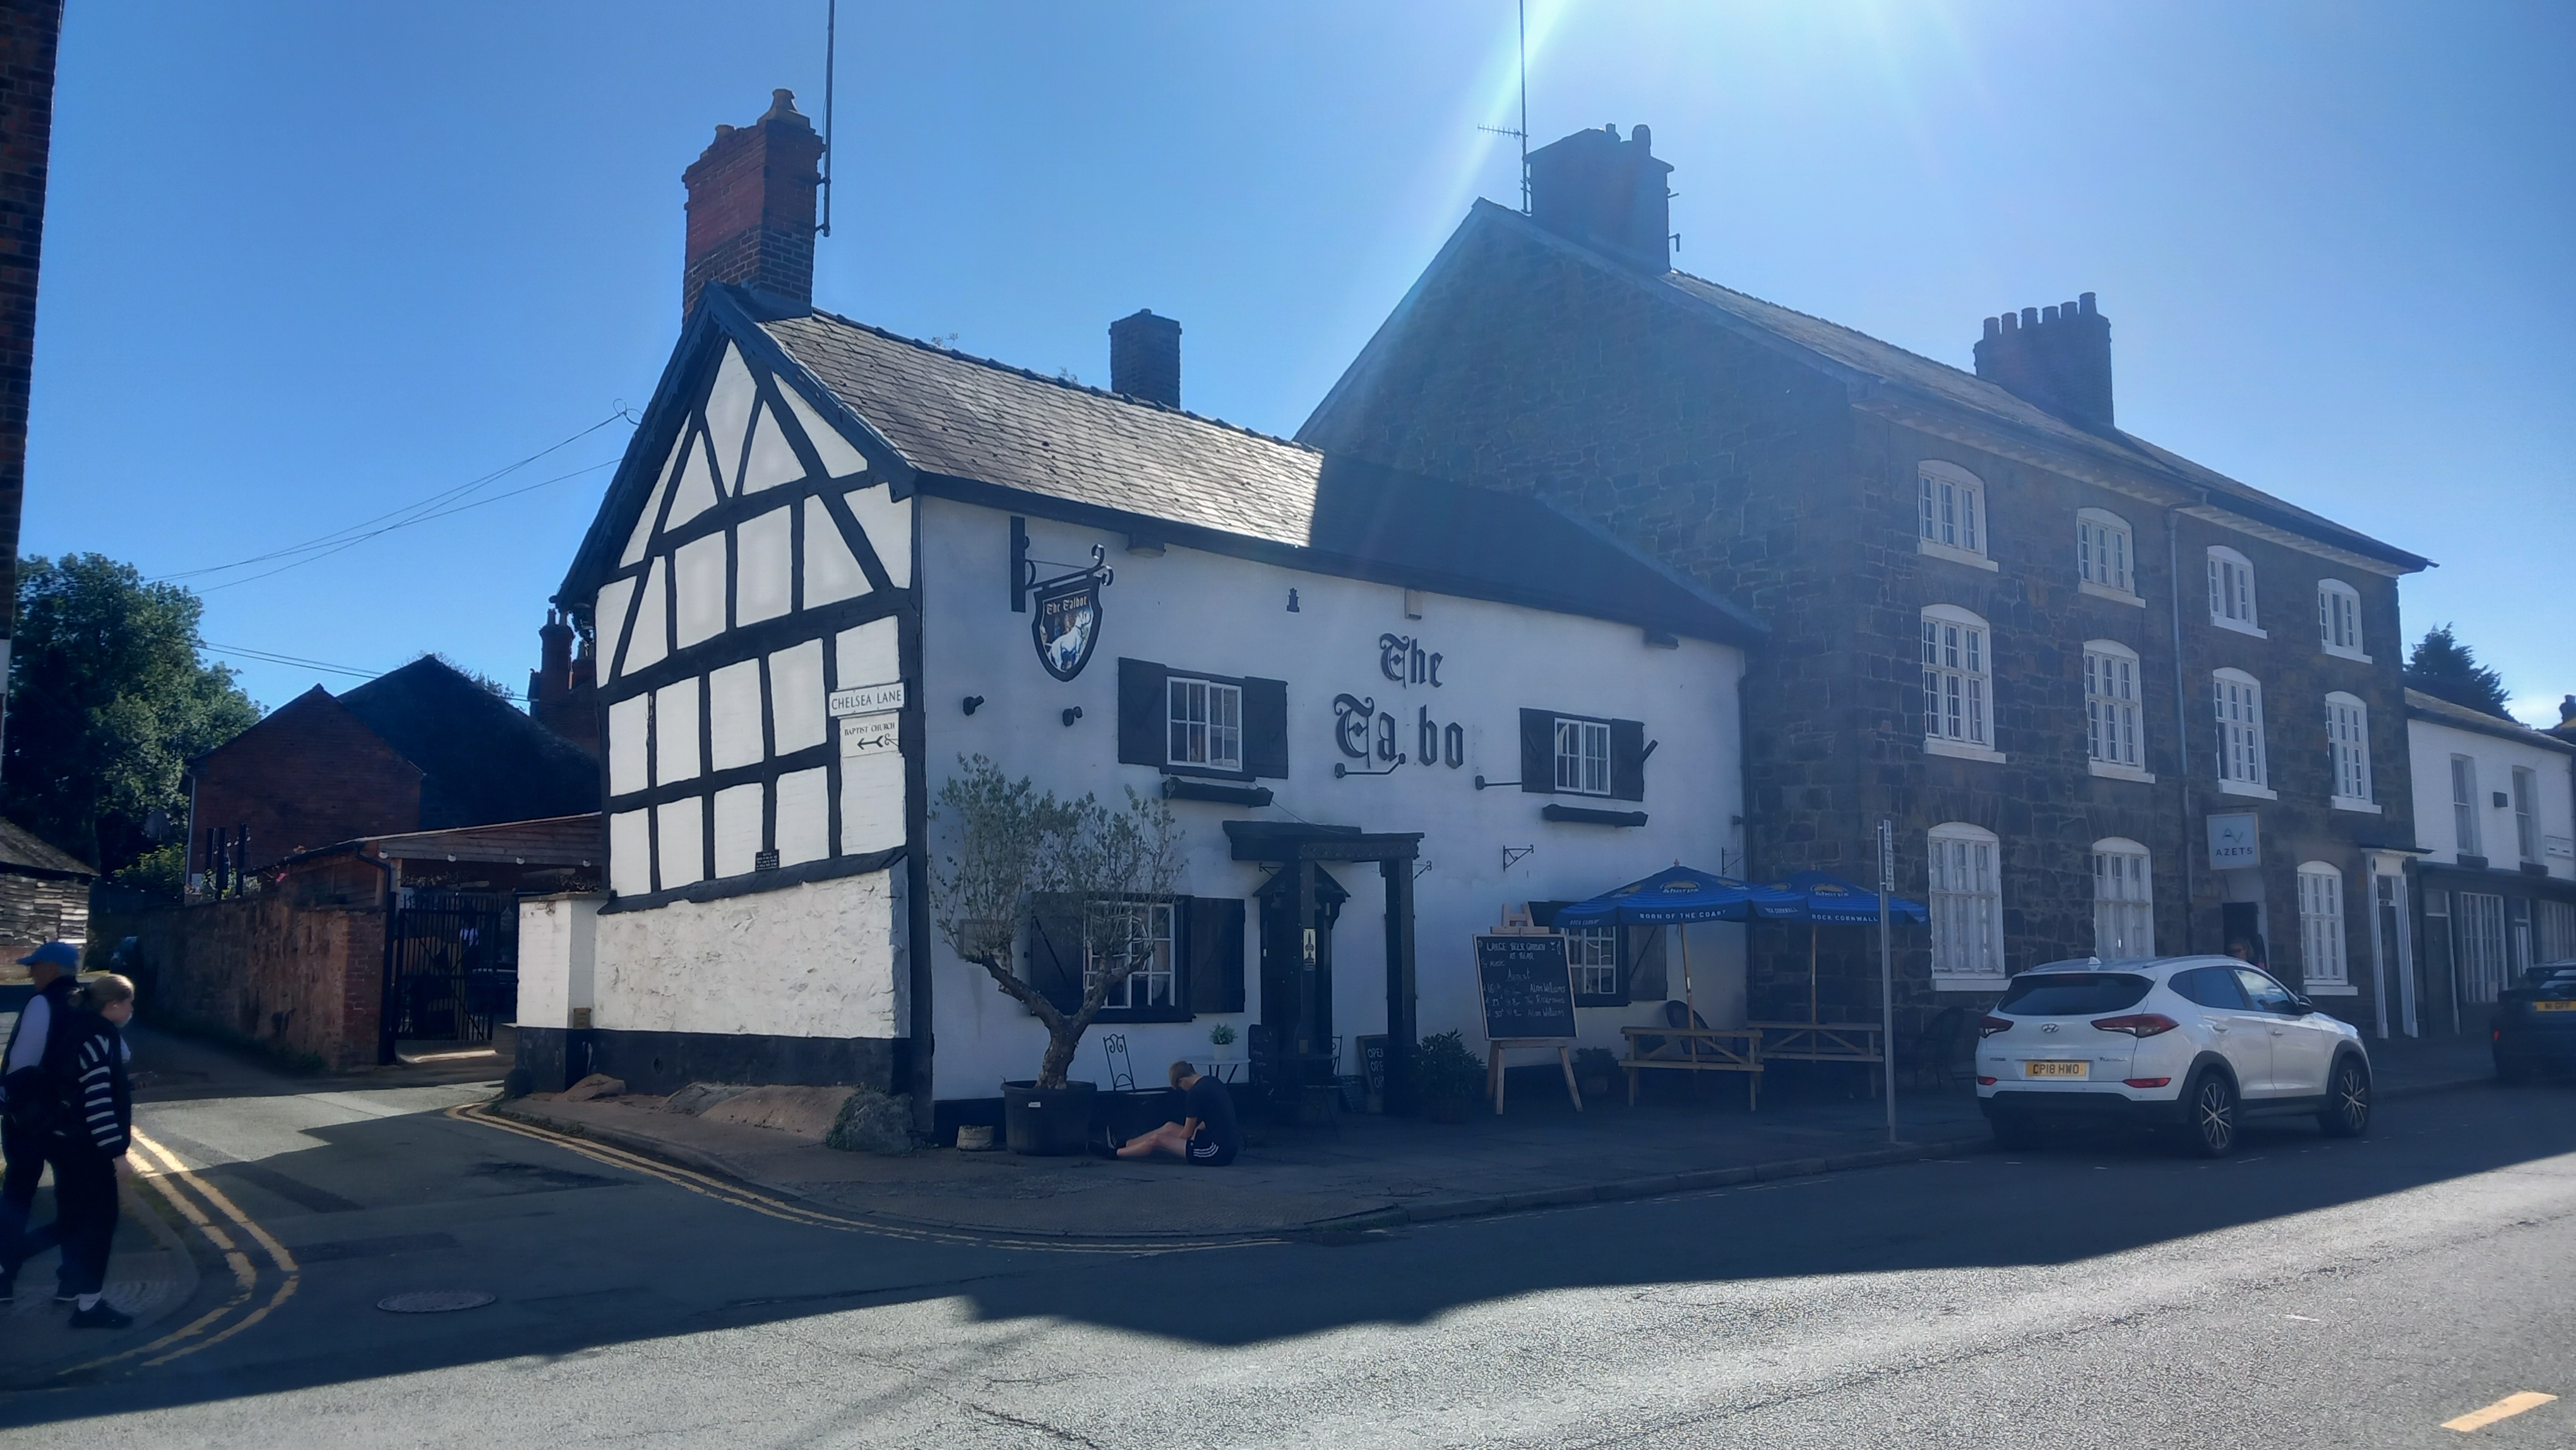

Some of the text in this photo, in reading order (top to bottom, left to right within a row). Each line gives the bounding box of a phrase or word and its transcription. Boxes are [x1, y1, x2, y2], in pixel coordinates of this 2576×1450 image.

[1047, 596, 1087, 615] The Talbot
[1379, 633, 1443, 689] The
[832, 690, 902, 710] CHELSEA LANE
[844, 722, 895, 736] BAPTIST CHURCH
[2215, 847, 2253, 856] AZETS
[1699, 909, 1726, 918] COAST
[1371, 1060, 1384, 1072] OPE
[2033, 1064, 2055, 1074] CP18
